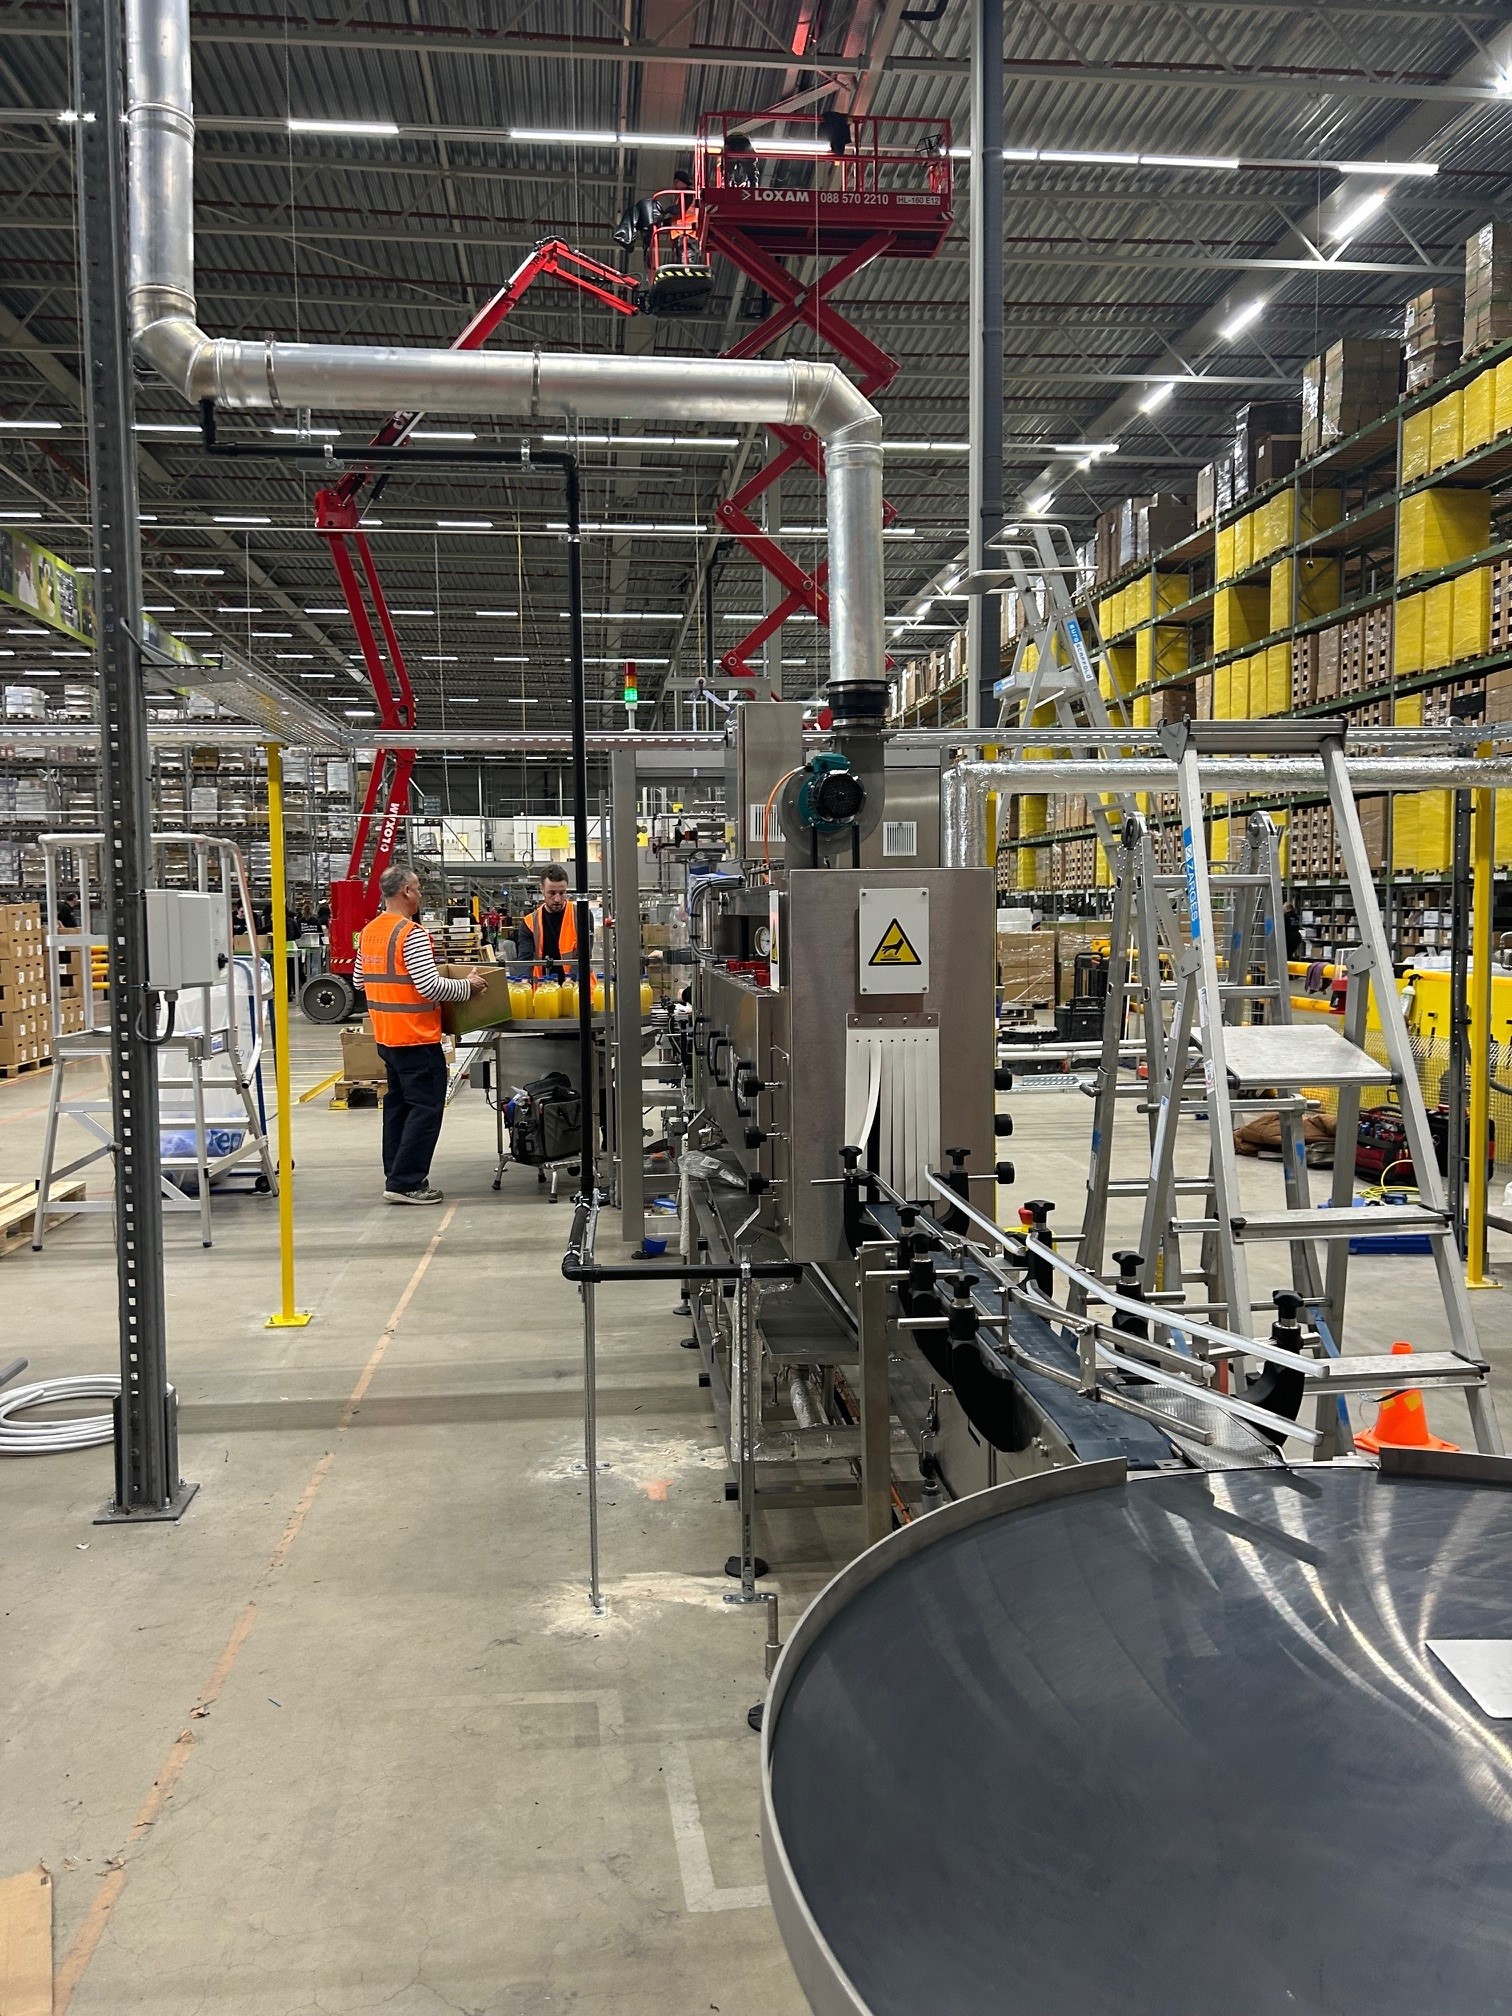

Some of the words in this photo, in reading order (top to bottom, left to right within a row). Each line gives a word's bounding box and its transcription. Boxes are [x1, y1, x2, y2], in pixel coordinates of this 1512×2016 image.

[753, 190, 810, 203] LOXAM
[820, 192, 840, 204] 088
[842, 193, 861, 204] 570
[863, 194, 889, 205] 2210
[926, 197, 940, 205] E12
[382, 802, 401, 844] LOXAM
[1186, 862, 1199, 922] ZARGES
